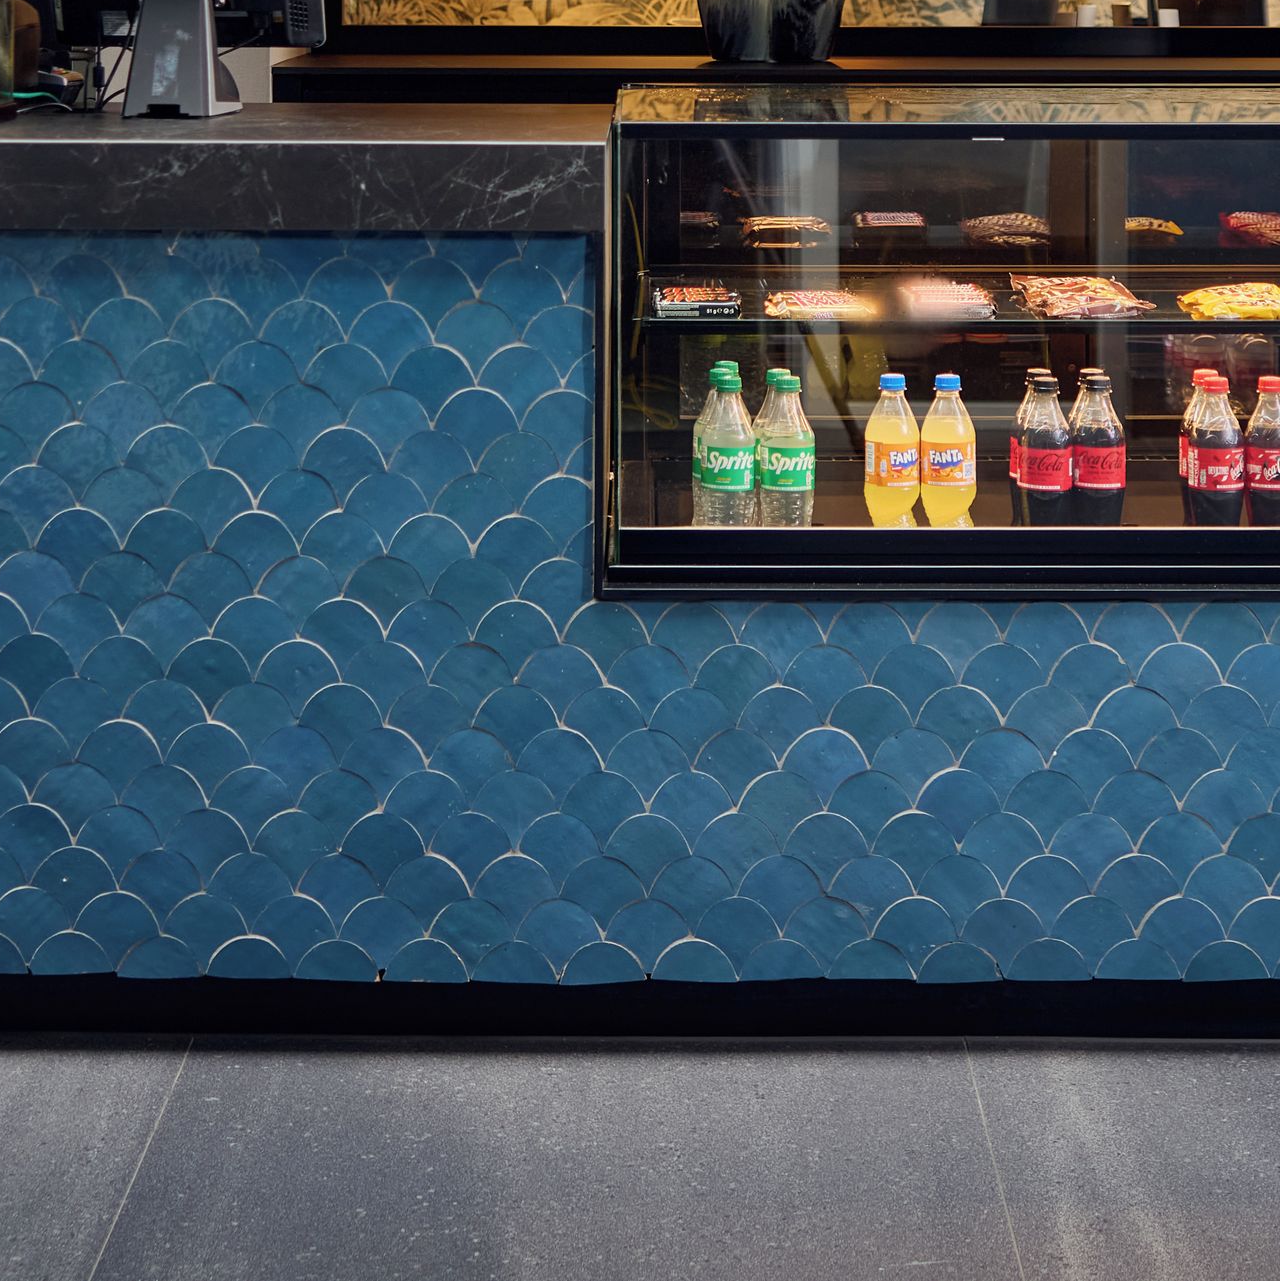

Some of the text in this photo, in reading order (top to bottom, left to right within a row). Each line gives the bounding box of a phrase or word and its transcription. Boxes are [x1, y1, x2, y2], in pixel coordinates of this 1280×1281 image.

[707, 450, 754, 473] Sprite
[769, 451, 815, 475] Sprite
[929, 449, 963, 464] FANTA
